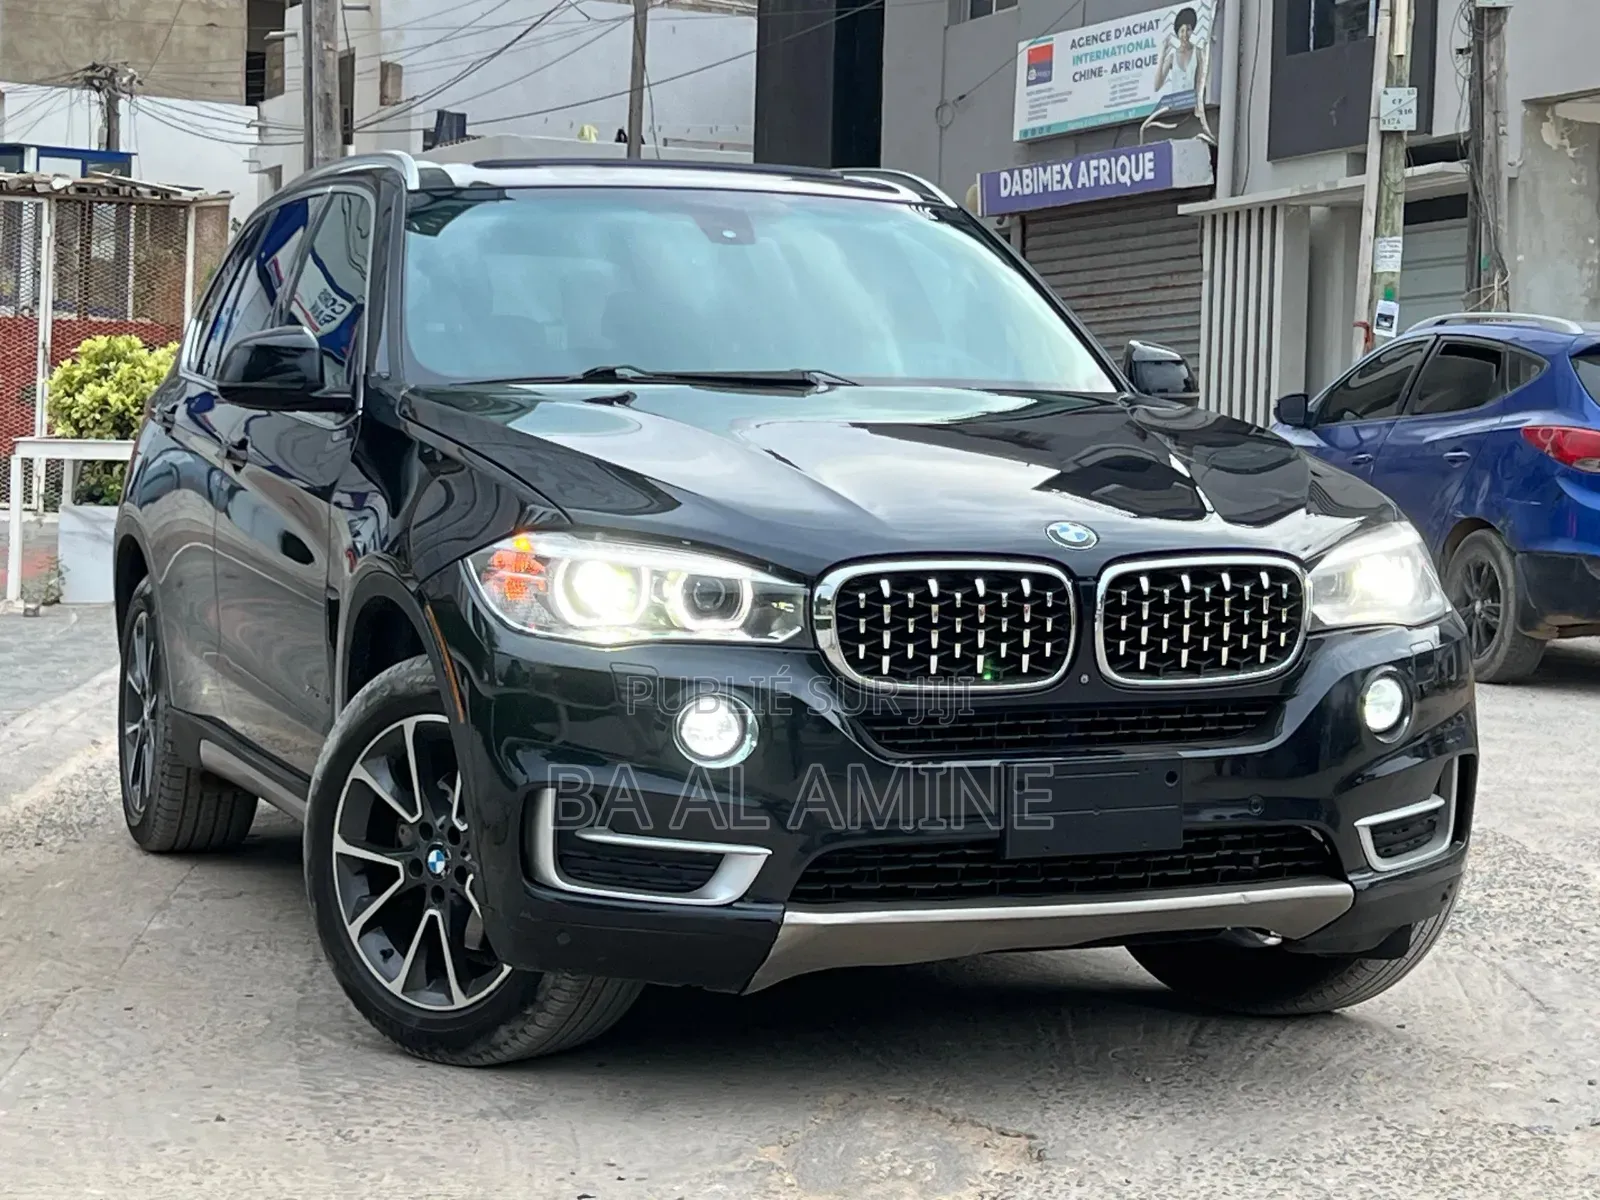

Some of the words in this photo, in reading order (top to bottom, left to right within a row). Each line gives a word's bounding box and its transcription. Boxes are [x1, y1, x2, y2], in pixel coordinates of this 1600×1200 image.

[1070, 30, 1112, 50] AGENCE
[1114, 19, 1160, 39] D'ACHAT
[1072, 38, 1156, 66] INTERNATIONAL
[1110, 54, 1158, 75] AFRIQUE
[1000, 162, 1074, 198] DABIMEX
[1077, 151, 1155, 189] AFRIQUE
